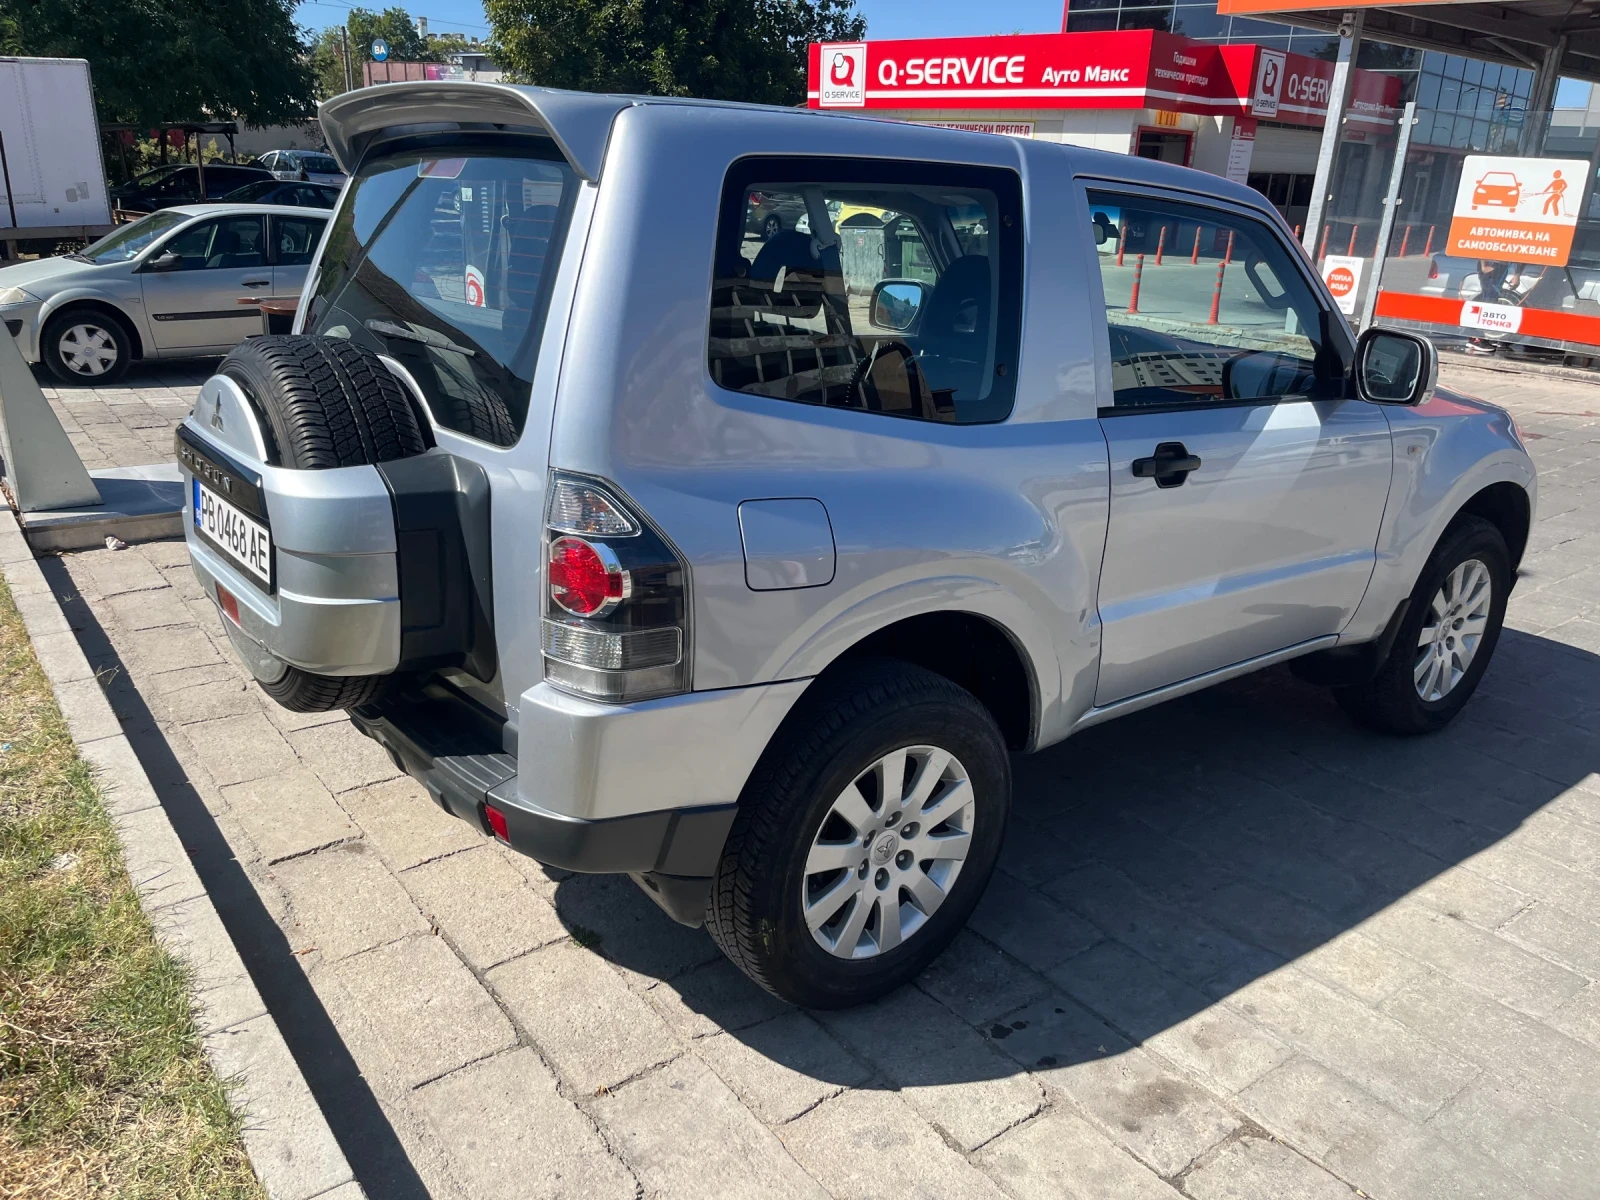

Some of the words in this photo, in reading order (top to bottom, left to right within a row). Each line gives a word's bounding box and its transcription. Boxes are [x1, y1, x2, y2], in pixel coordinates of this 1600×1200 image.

[1041, 66, 1080, 87] Ауто
[1083, 65, 1130, 82] Макс
[1469, 226, 1533, 241] АВТОМИВКА
[1535, 230, 1551, 242] НА
[1457, 239, 1558, 257] САМООБСЛУЖВАНЕ
[1330, 274, 1352, 282] ТОПЛА
[1330, 282, 1349, 291] ВОДА
[1482, 311, 1507, 320] авто
[1481, 319, 1512, 328] точка
[201, 489, 216, 533] PB
[217, 502, 247, 558] 0468
[249, 526, 268, 576] AE
